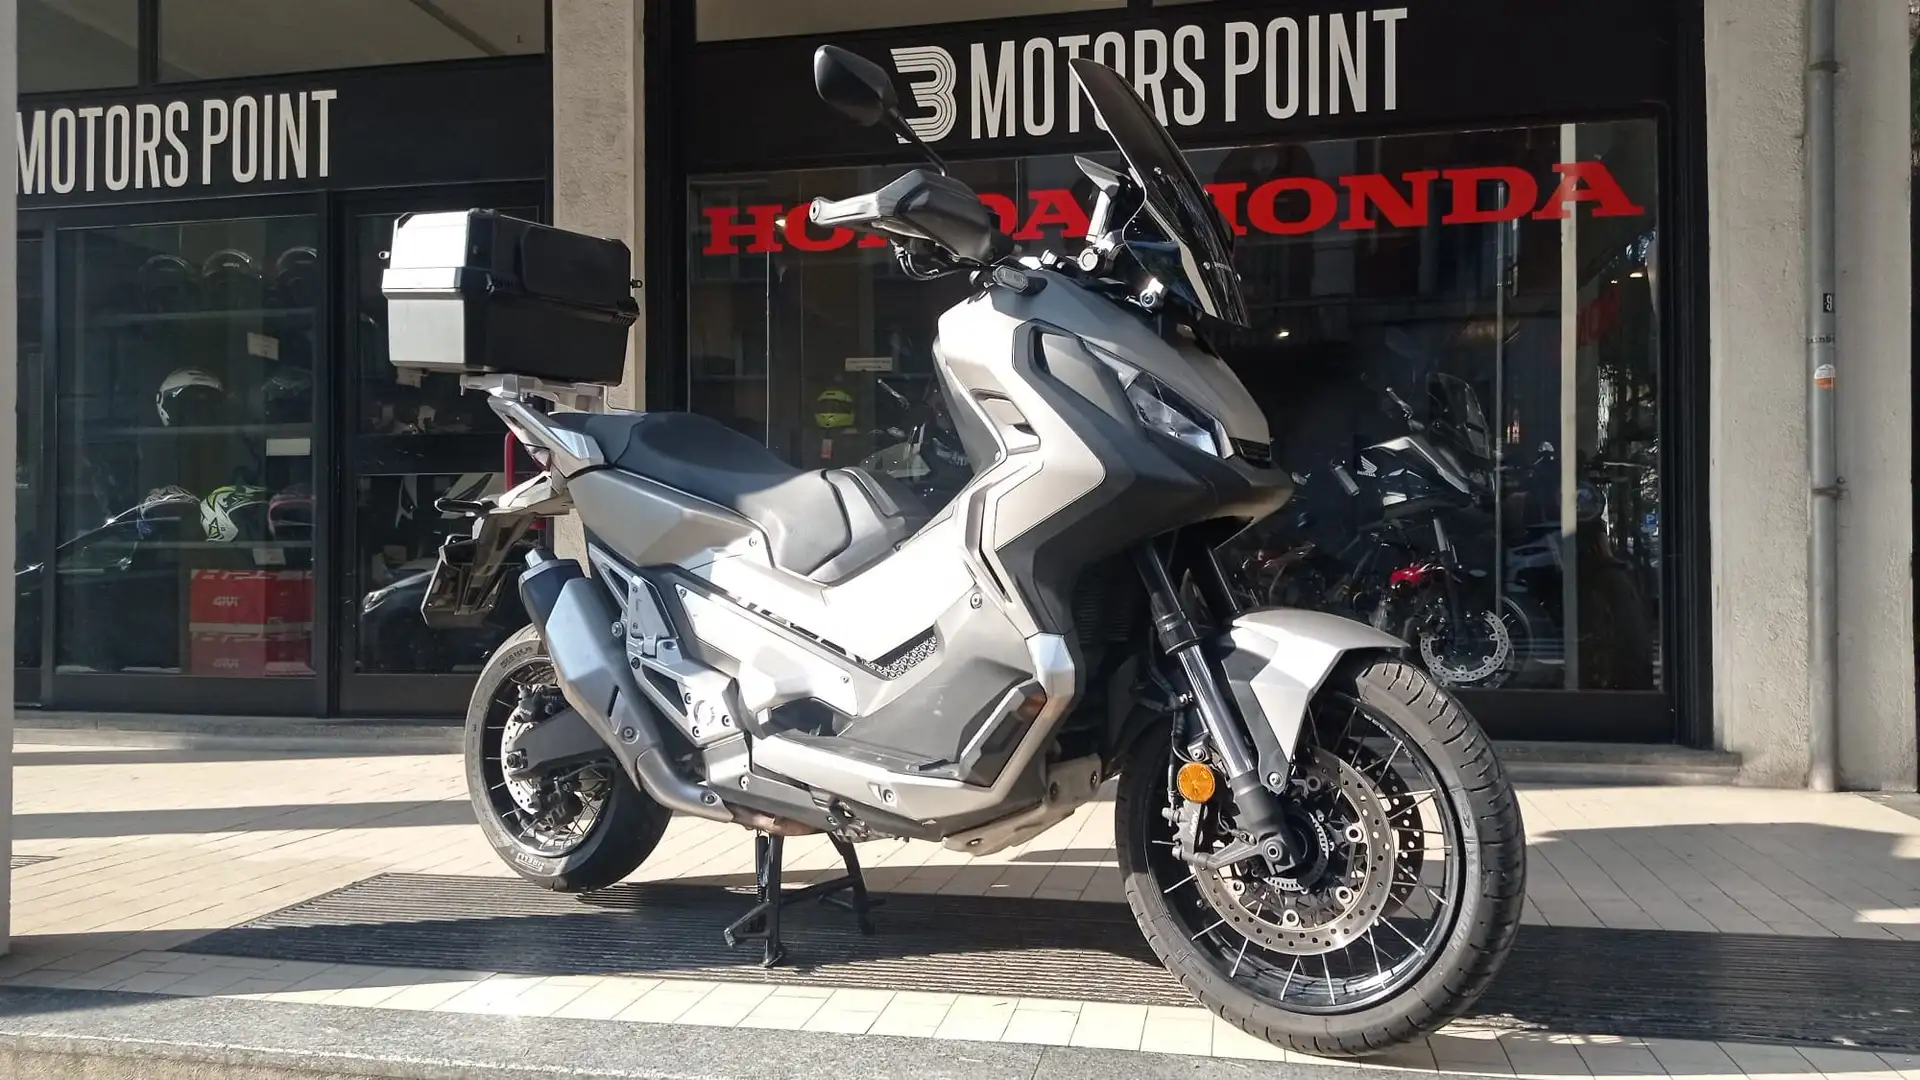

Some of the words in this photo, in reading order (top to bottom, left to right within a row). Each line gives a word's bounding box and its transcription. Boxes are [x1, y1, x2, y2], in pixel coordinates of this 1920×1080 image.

[1225, 7, 1408, 123] POINT
[17, 101, 189, 195] MOTORS
[202, 89, 337, 185] POINT
[702, 189, 1093, 255] HOA
